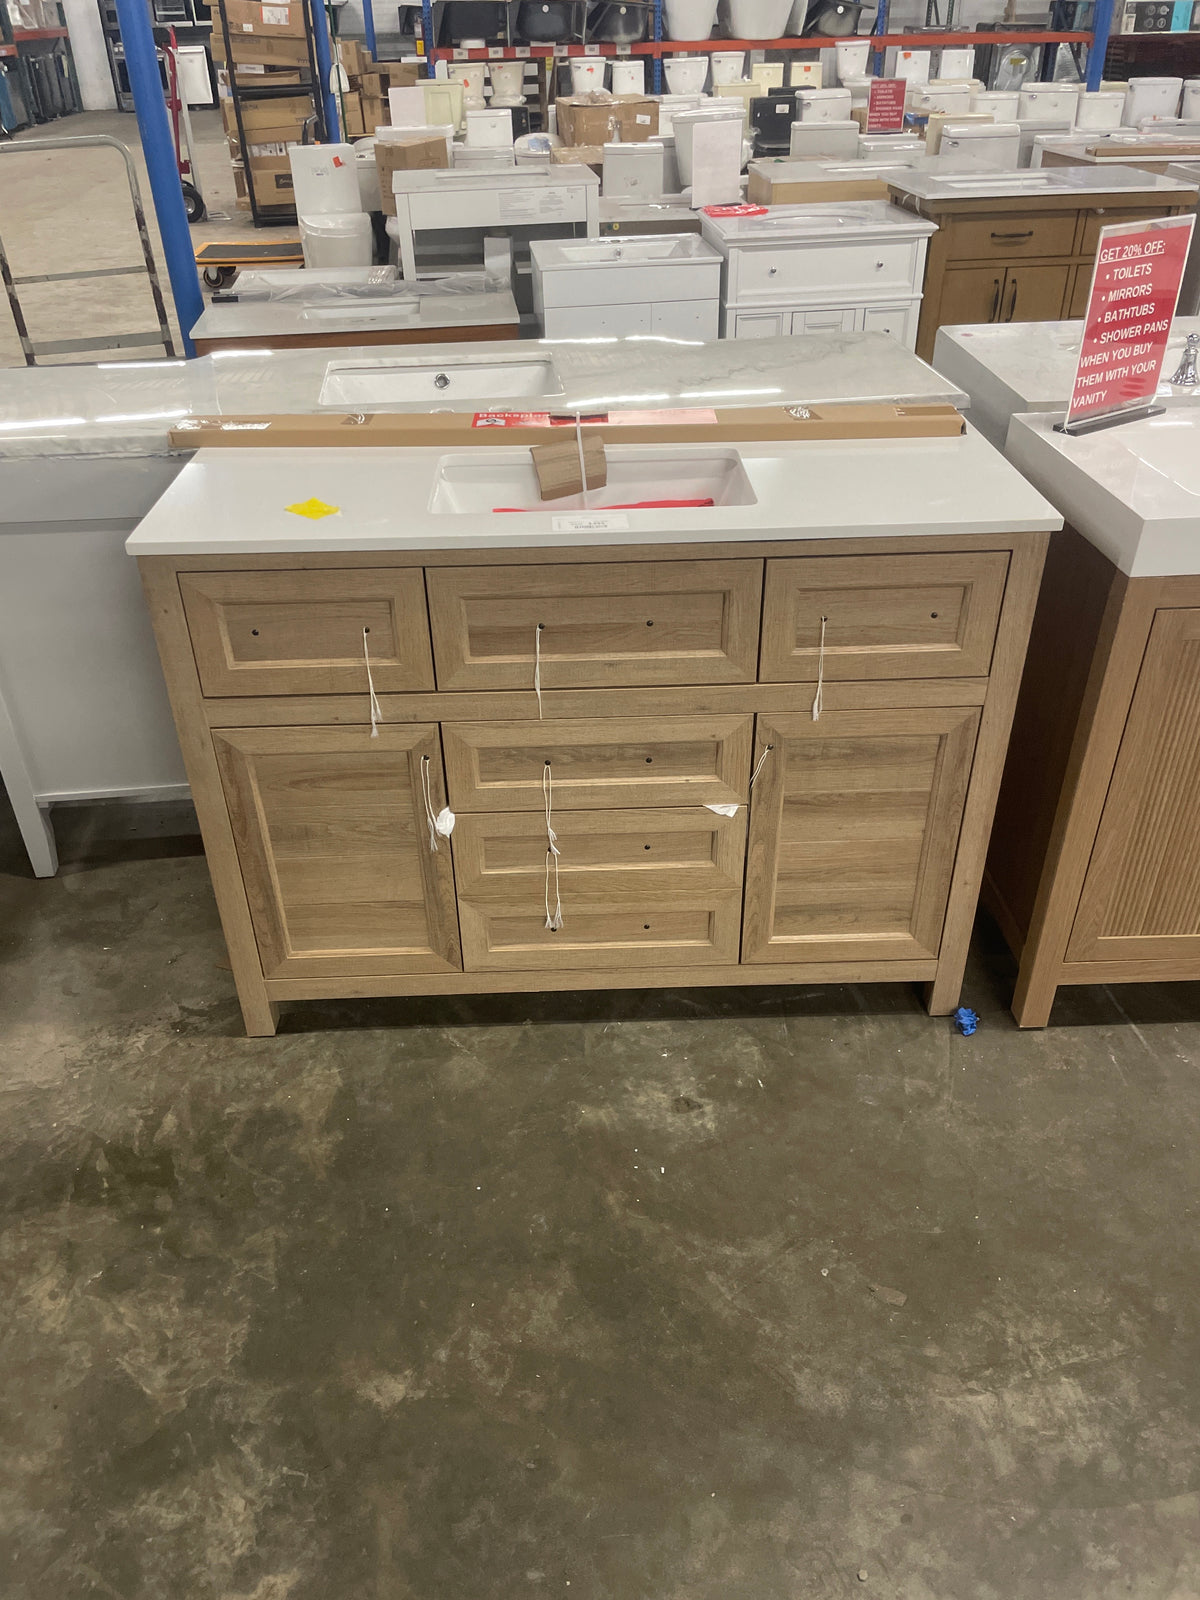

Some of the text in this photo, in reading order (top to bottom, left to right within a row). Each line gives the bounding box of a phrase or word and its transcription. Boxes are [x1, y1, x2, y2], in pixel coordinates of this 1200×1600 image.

[1100, 240, 1166, 262] GET 20% OFF:
[1113, 263, 1153, 280] TOILETS
[1108, 283, 1153, 302] MIRRORS
[1104, 302, 1155, 323] BATHTUBS
[1100, 320, 1169, 344] SHOWER PANS
[1080, 341, 1153, 368] WHEN YOU BUY
[1077, 360, 1157, 388] THEM WITH YOUR
[1073, 390, 1107, 408] VANITY
